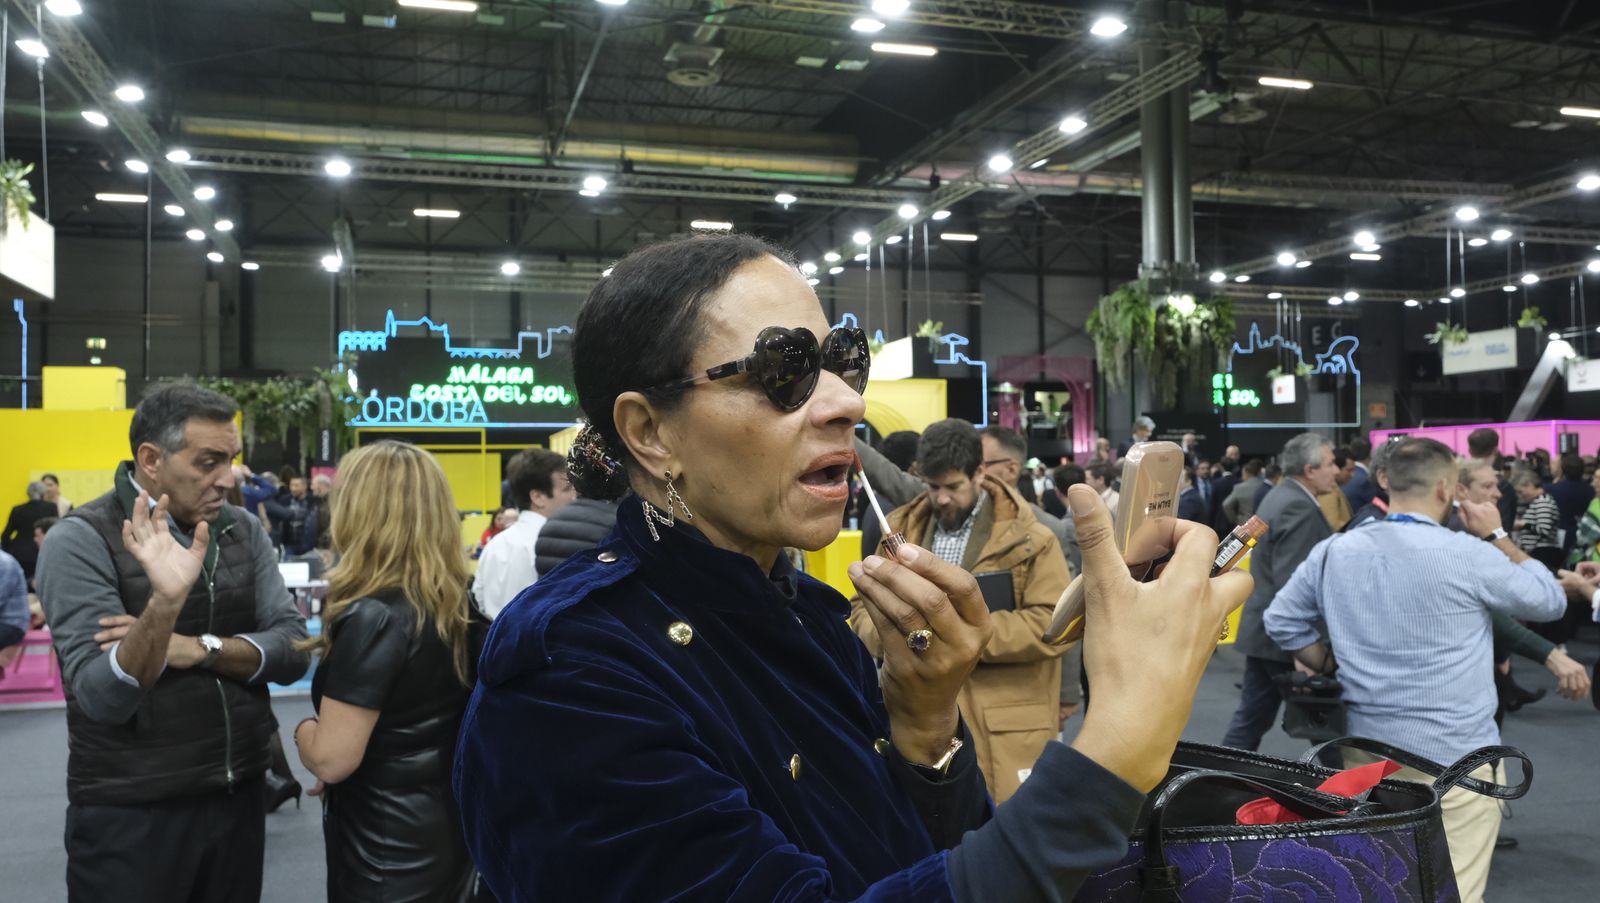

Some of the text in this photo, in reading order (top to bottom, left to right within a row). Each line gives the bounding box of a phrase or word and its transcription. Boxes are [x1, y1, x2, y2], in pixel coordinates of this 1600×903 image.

[446, 363, 534, 384] MÁLAGA
[410, 384, 572, 405] COSTA DEL SOL
[1228, 389, 1260, 407] SOL
[347, 389, 489, 423] ÓRDOBA
